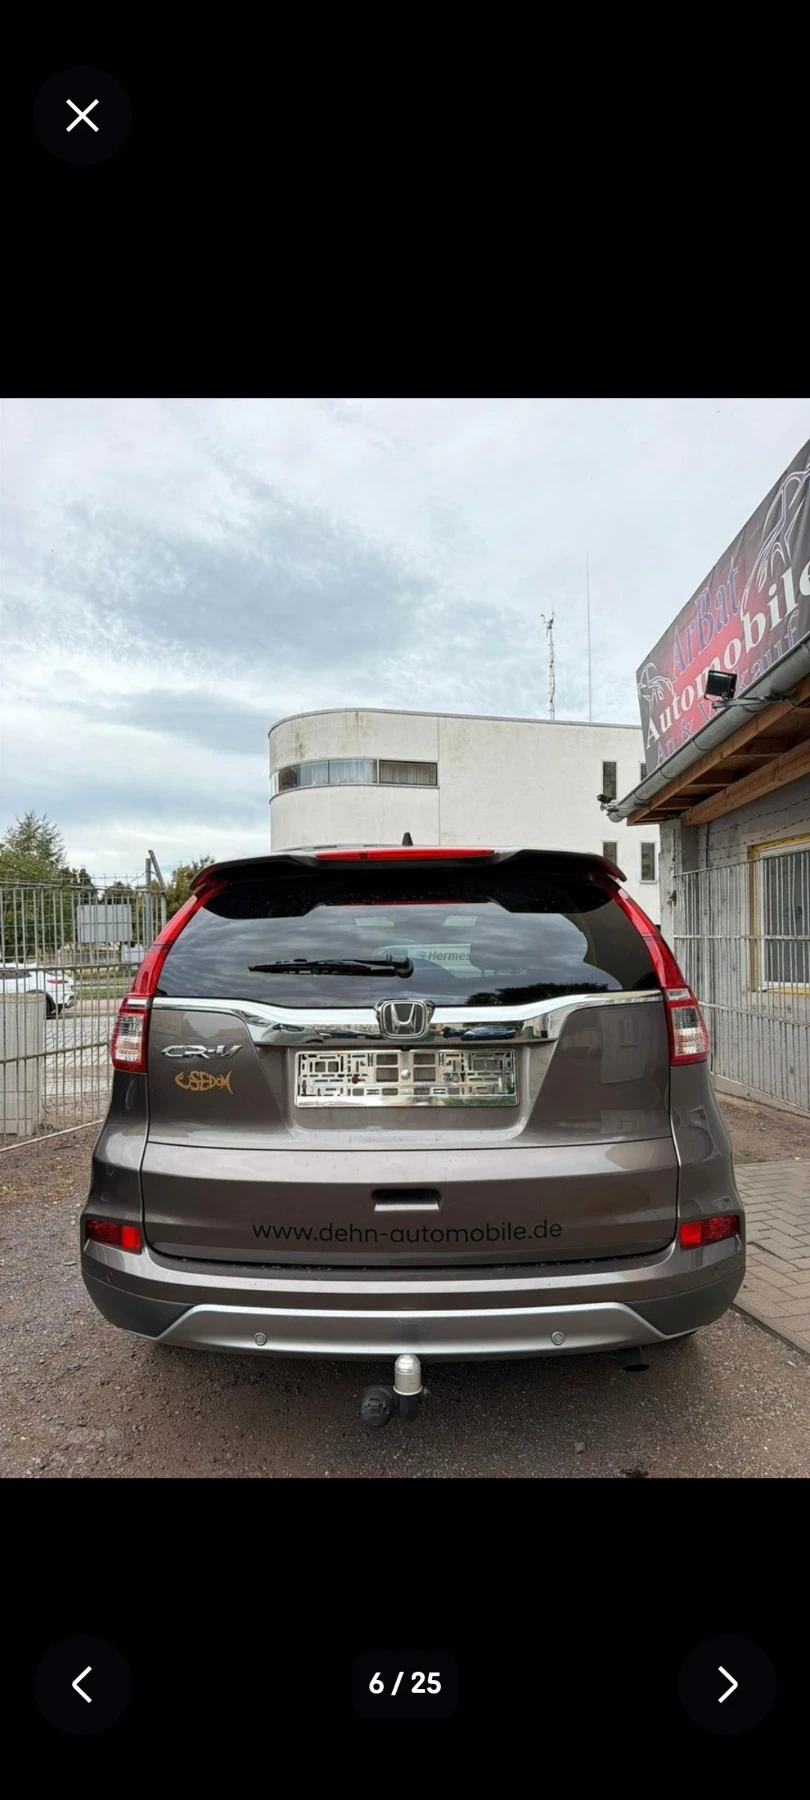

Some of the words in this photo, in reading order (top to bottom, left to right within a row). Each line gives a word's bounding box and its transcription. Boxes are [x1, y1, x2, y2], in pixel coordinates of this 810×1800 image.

[671, 556, 741, 683] ArBat
[656, 737, 675, 769] An
[679, 717, 694, 743] &
[697, 610, 799, 723] Vkauf
[428, 950, 471, 961] Hermes
[160, 1044, 243, 1060] CR-V
[174, 1069, 234, 1096] USEDOM
[252, 1219, 563, 1244] www.dehn-automobile.de
